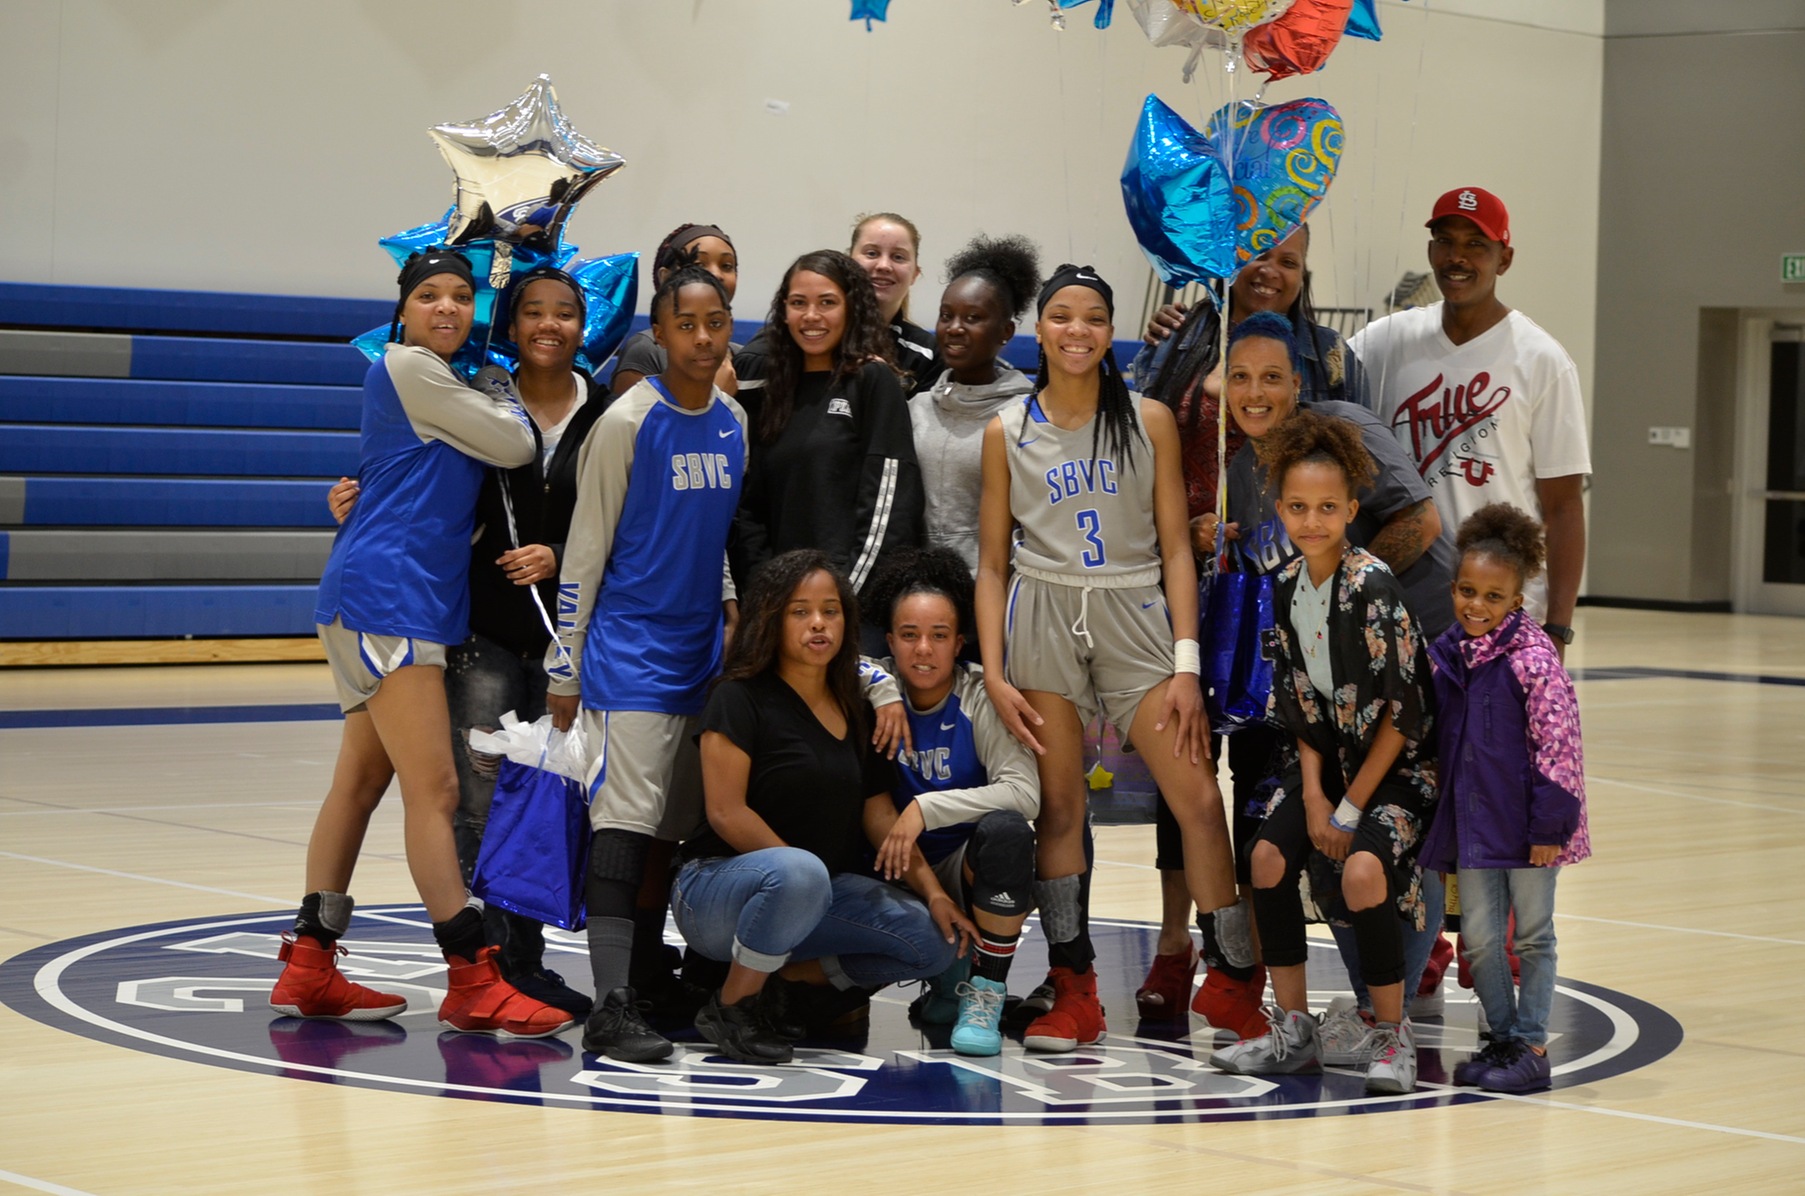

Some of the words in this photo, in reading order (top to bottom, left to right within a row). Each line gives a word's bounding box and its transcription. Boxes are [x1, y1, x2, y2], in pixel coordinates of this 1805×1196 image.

[1391, 371, 1510, 472] True
[671, 452, 732, 491] SBVC
[1044, 458, 1118, 506] SBVC
[1075, 508, 1107, 569] 3
